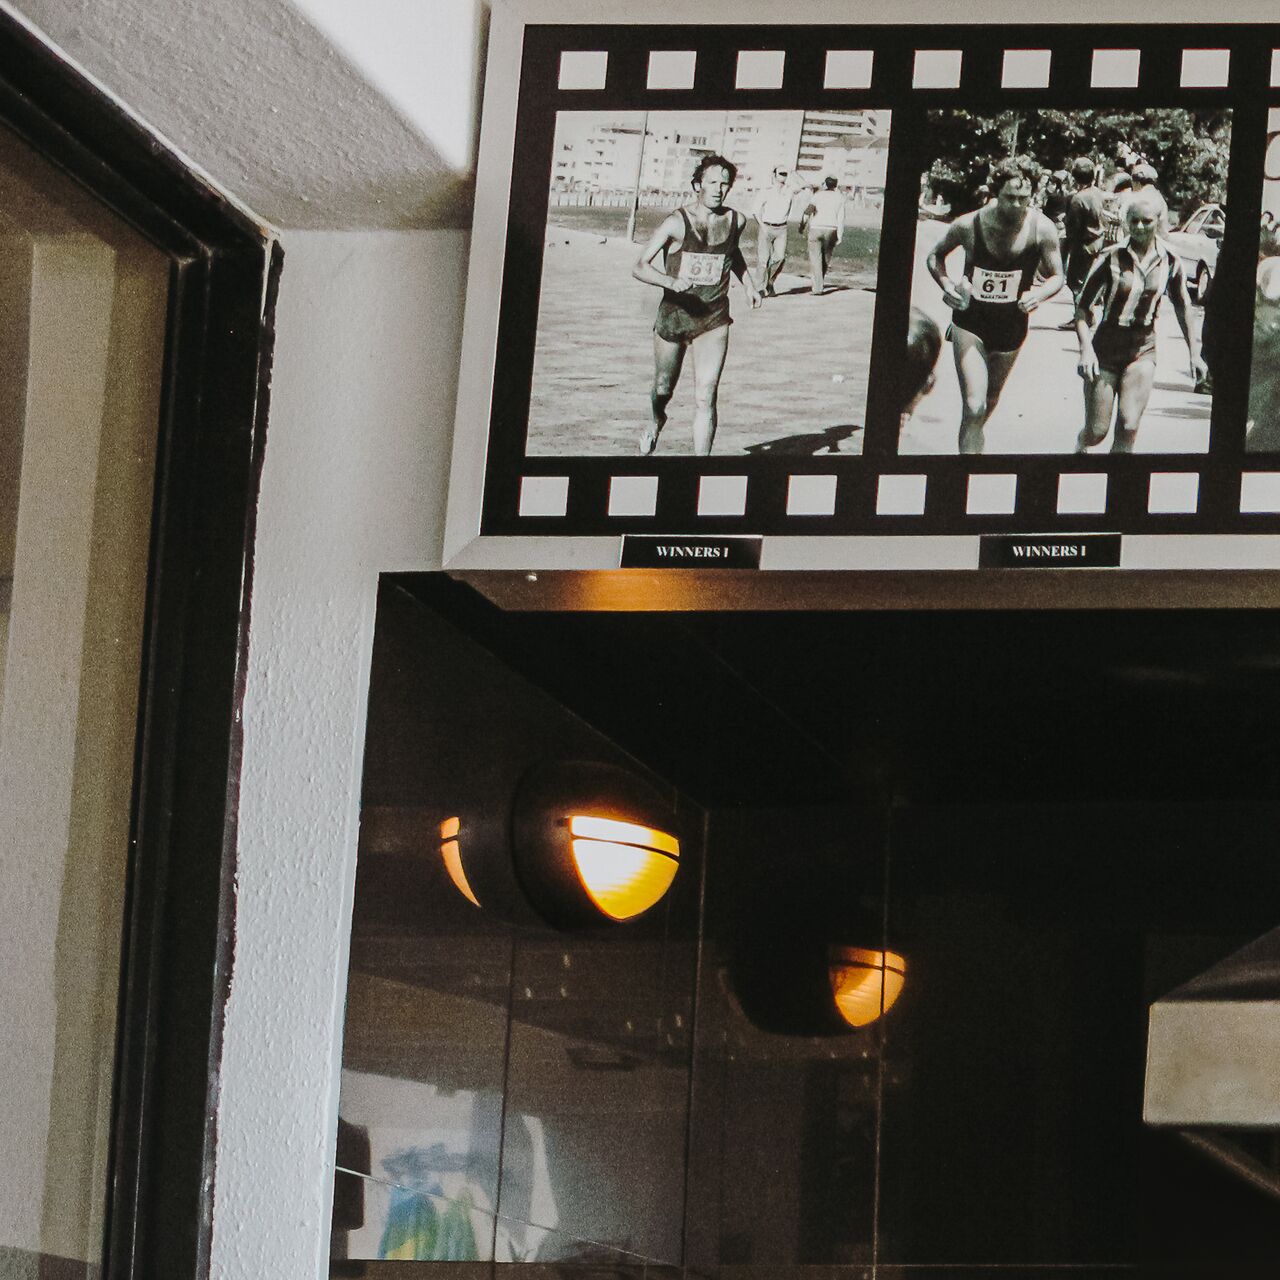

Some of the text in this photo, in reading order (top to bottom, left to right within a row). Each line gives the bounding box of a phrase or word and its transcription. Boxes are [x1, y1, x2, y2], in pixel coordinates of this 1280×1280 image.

[691, 261, 713, 275] 61
[982, 279, 1007, 293] 61
[656, 545, 729, 558] WINNERS I
[1012, 545, 1086, 558] WINNERS I
